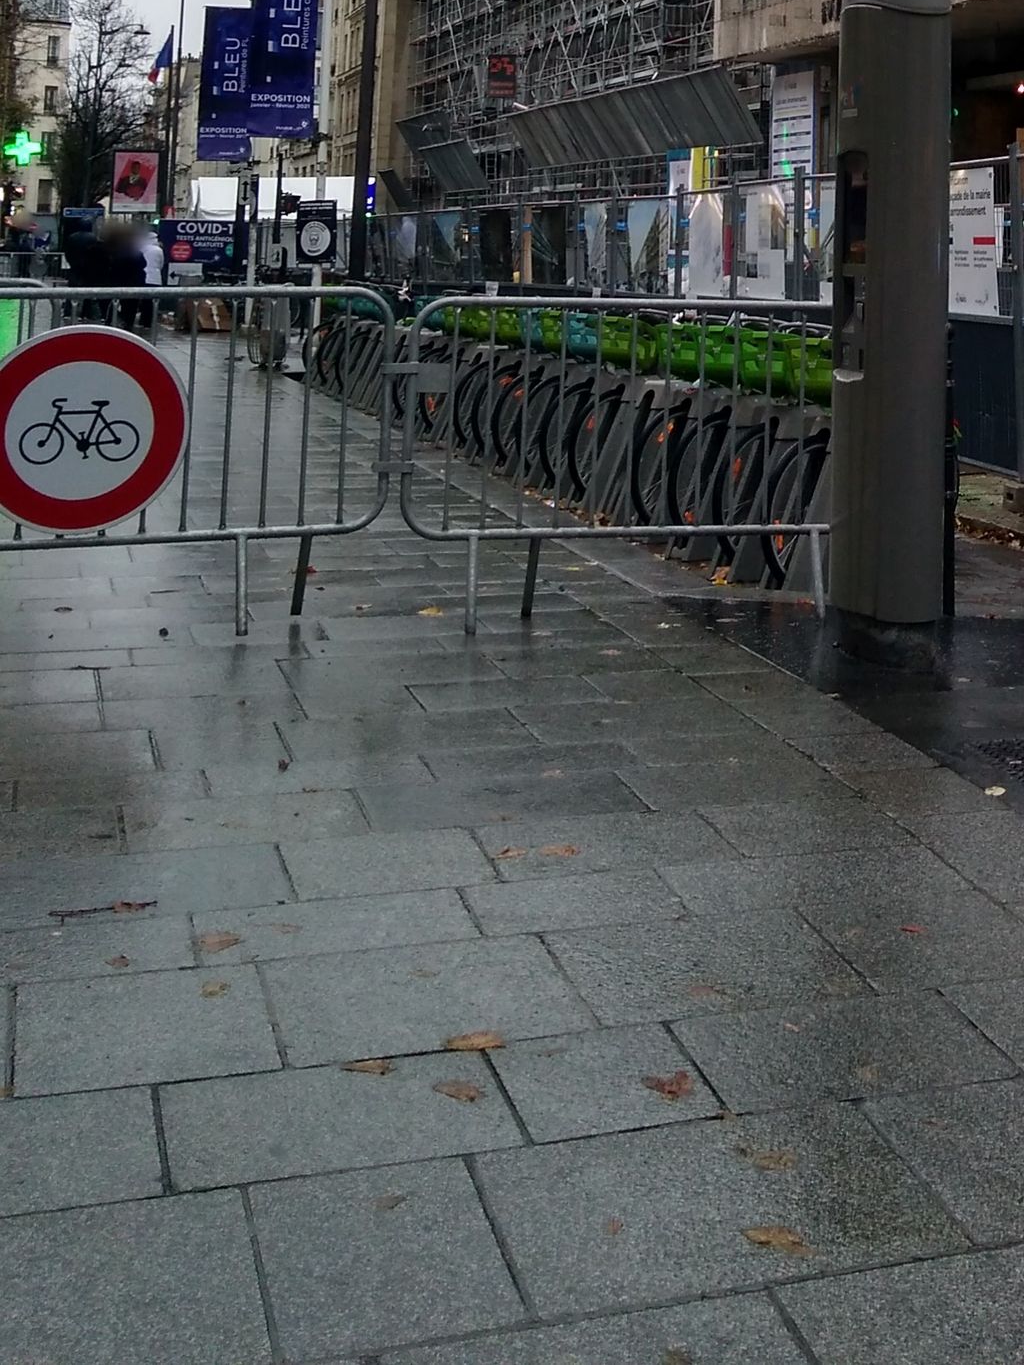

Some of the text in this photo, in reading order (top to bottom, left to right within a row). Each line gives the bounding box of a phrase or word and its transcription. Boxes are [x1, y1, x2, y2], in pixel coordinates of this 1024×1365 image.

[300, 7, 311, 50] Peintures
[223, 38, 241, 92] BLEU
[250, 93, 311, 103] EXPOSITION
[963, 189, 969, 200] de
[970, 189, 975, 200] la
[975, 188, 991, 199] mairie
[176, 222, 234, 235] COVID-1
